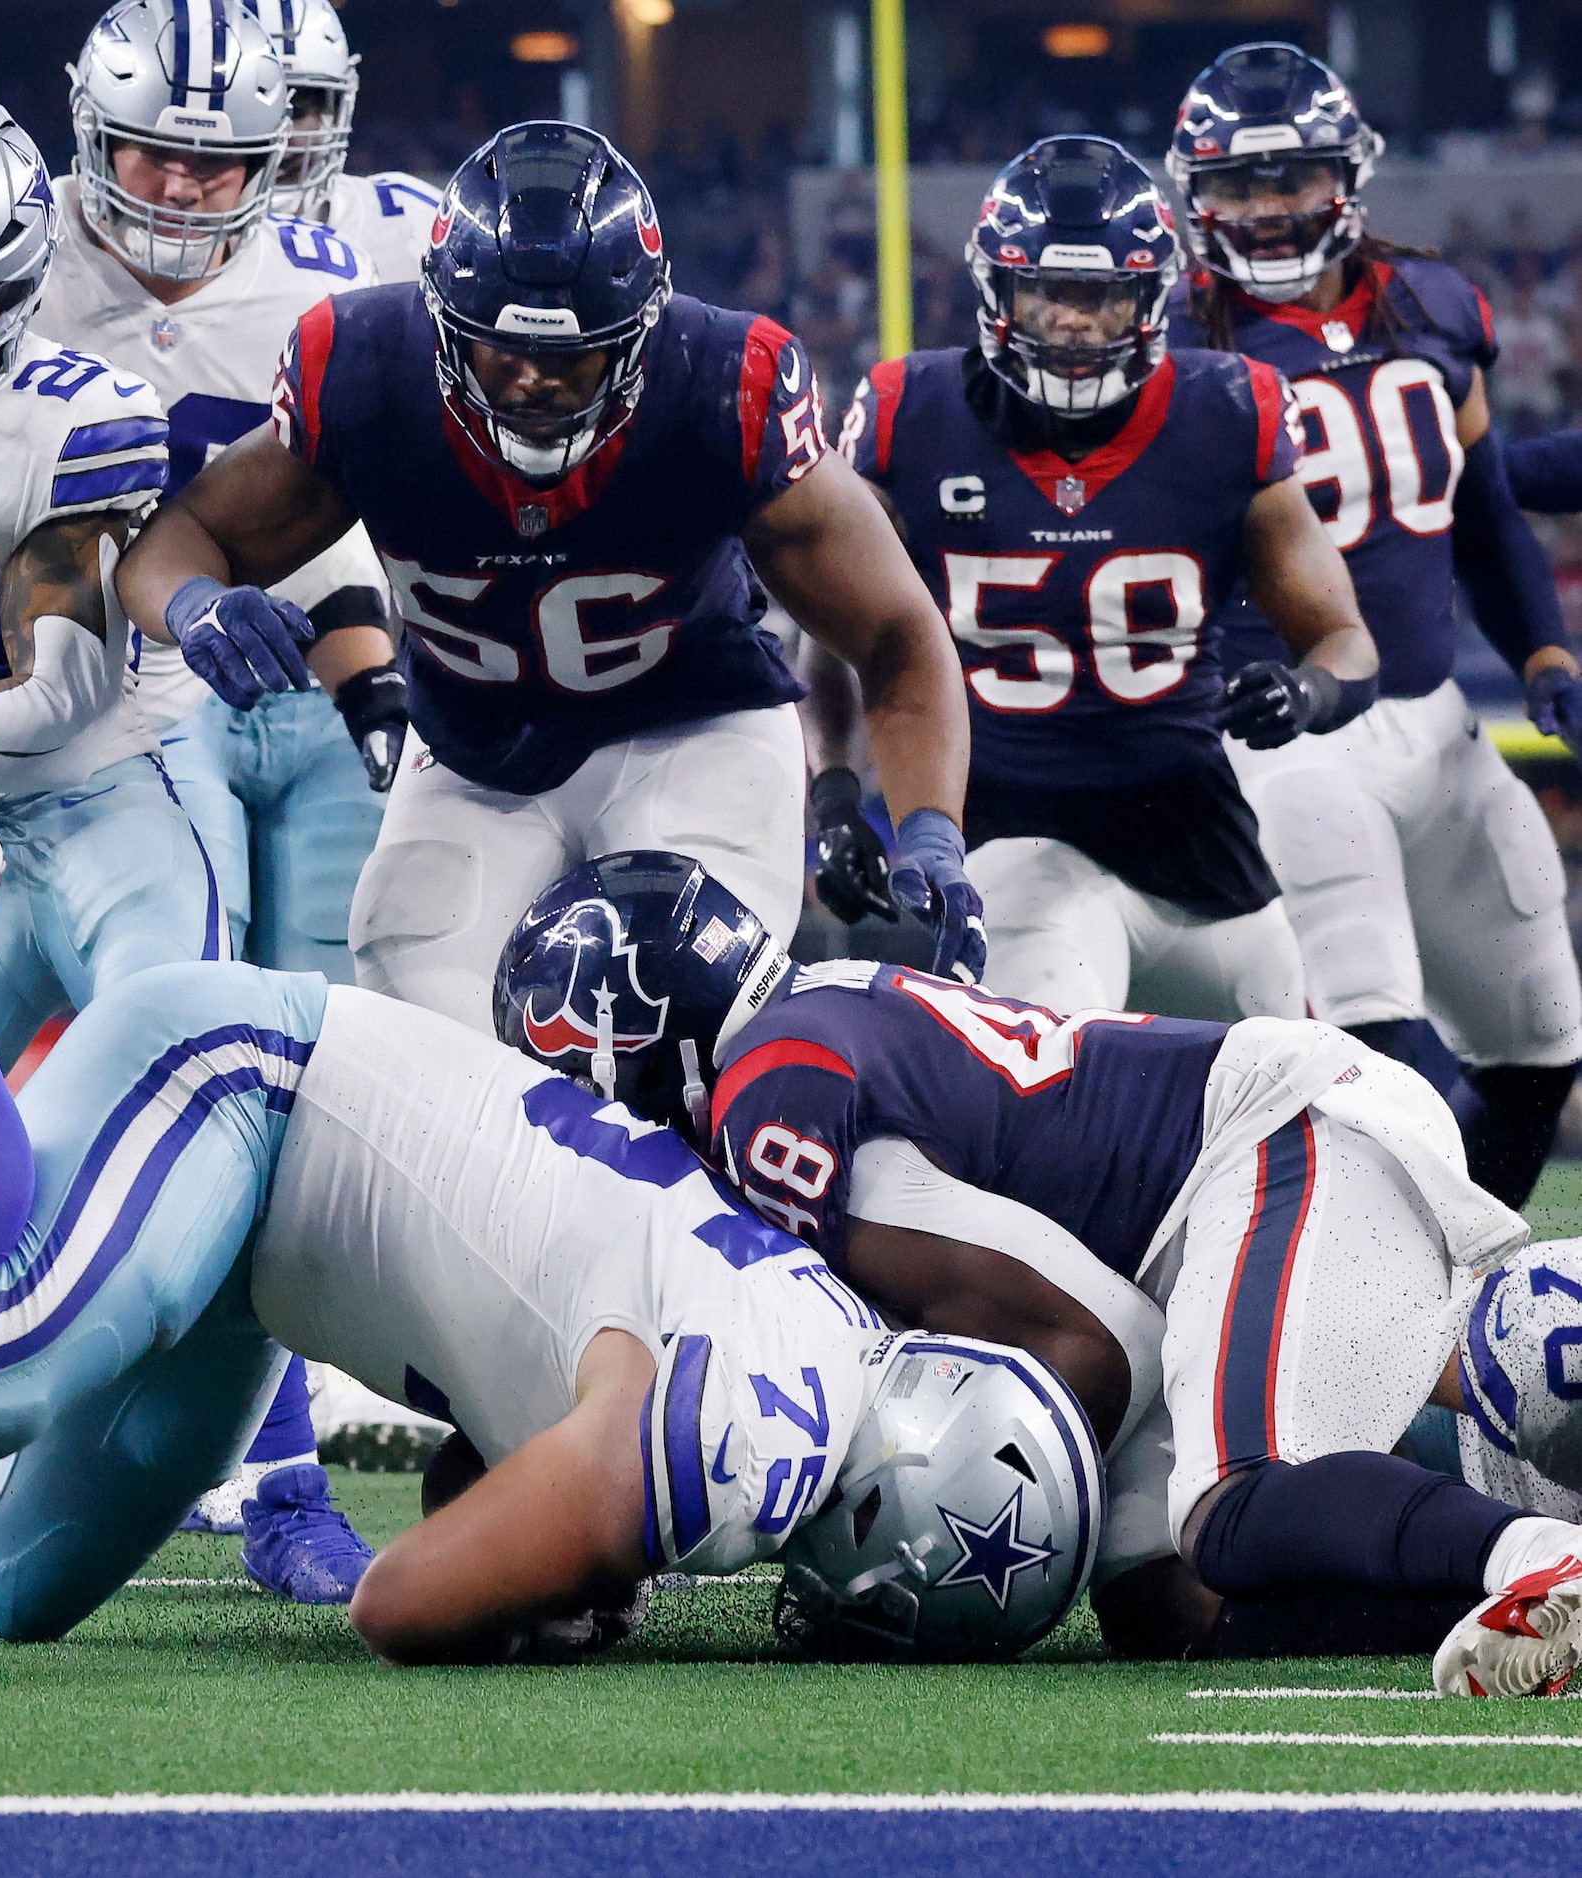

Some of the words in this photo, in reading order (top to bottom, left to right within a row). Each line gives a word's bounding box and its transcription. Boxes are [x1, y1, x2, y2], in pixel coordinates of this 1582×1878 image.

[939, 475, 986, 513] C
[1290, 356, 1465, 553] 90
[1031, 529, 1114, 542] TEXANS
[378, 549, 683, 693] 56
[939, 547, 1207, 714] 58
[747, 958, 782, 1010] INSPIRE
[743, 1121, 838, 1238] 48
[748, 1366, 830, 1534] 75
